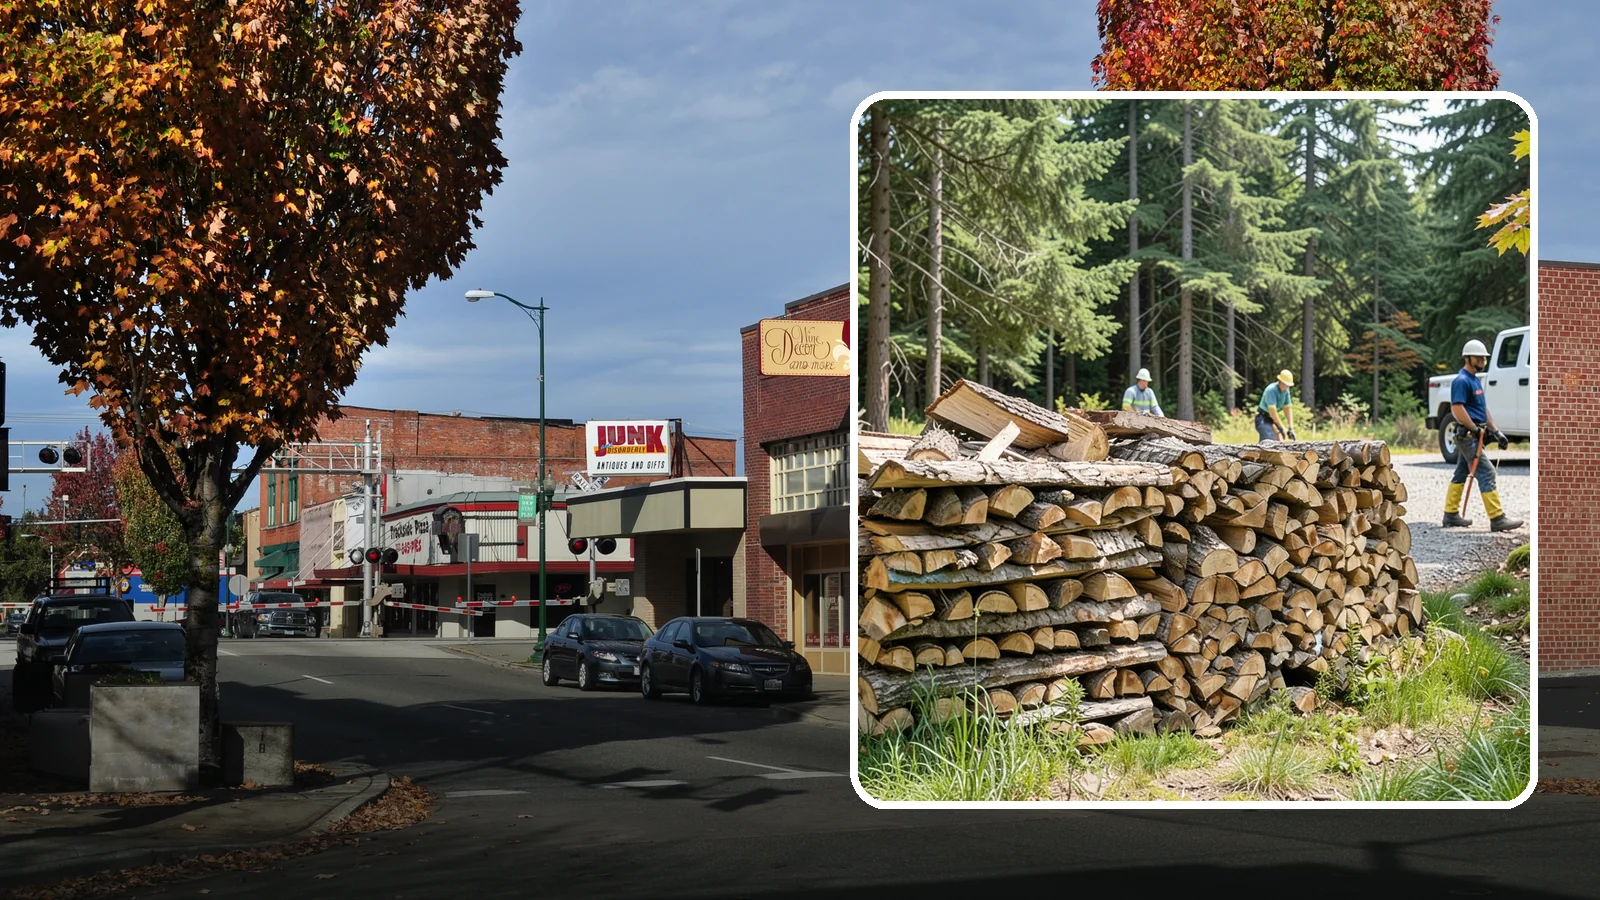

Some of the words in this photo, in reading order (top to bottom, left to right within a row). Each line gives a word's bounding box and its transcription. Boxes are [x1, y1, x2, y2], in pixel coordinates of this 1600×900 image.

[596, 425, 664, 457] JUNK
[607, 446, 646, 454] DISORDERLY
[597, 461, 628, 470] ANTIQUES
[631, 461, 644, 470] AND
[647, 460, 665, 470] GIFTS
[414, 519, 429, 535] Pizza
